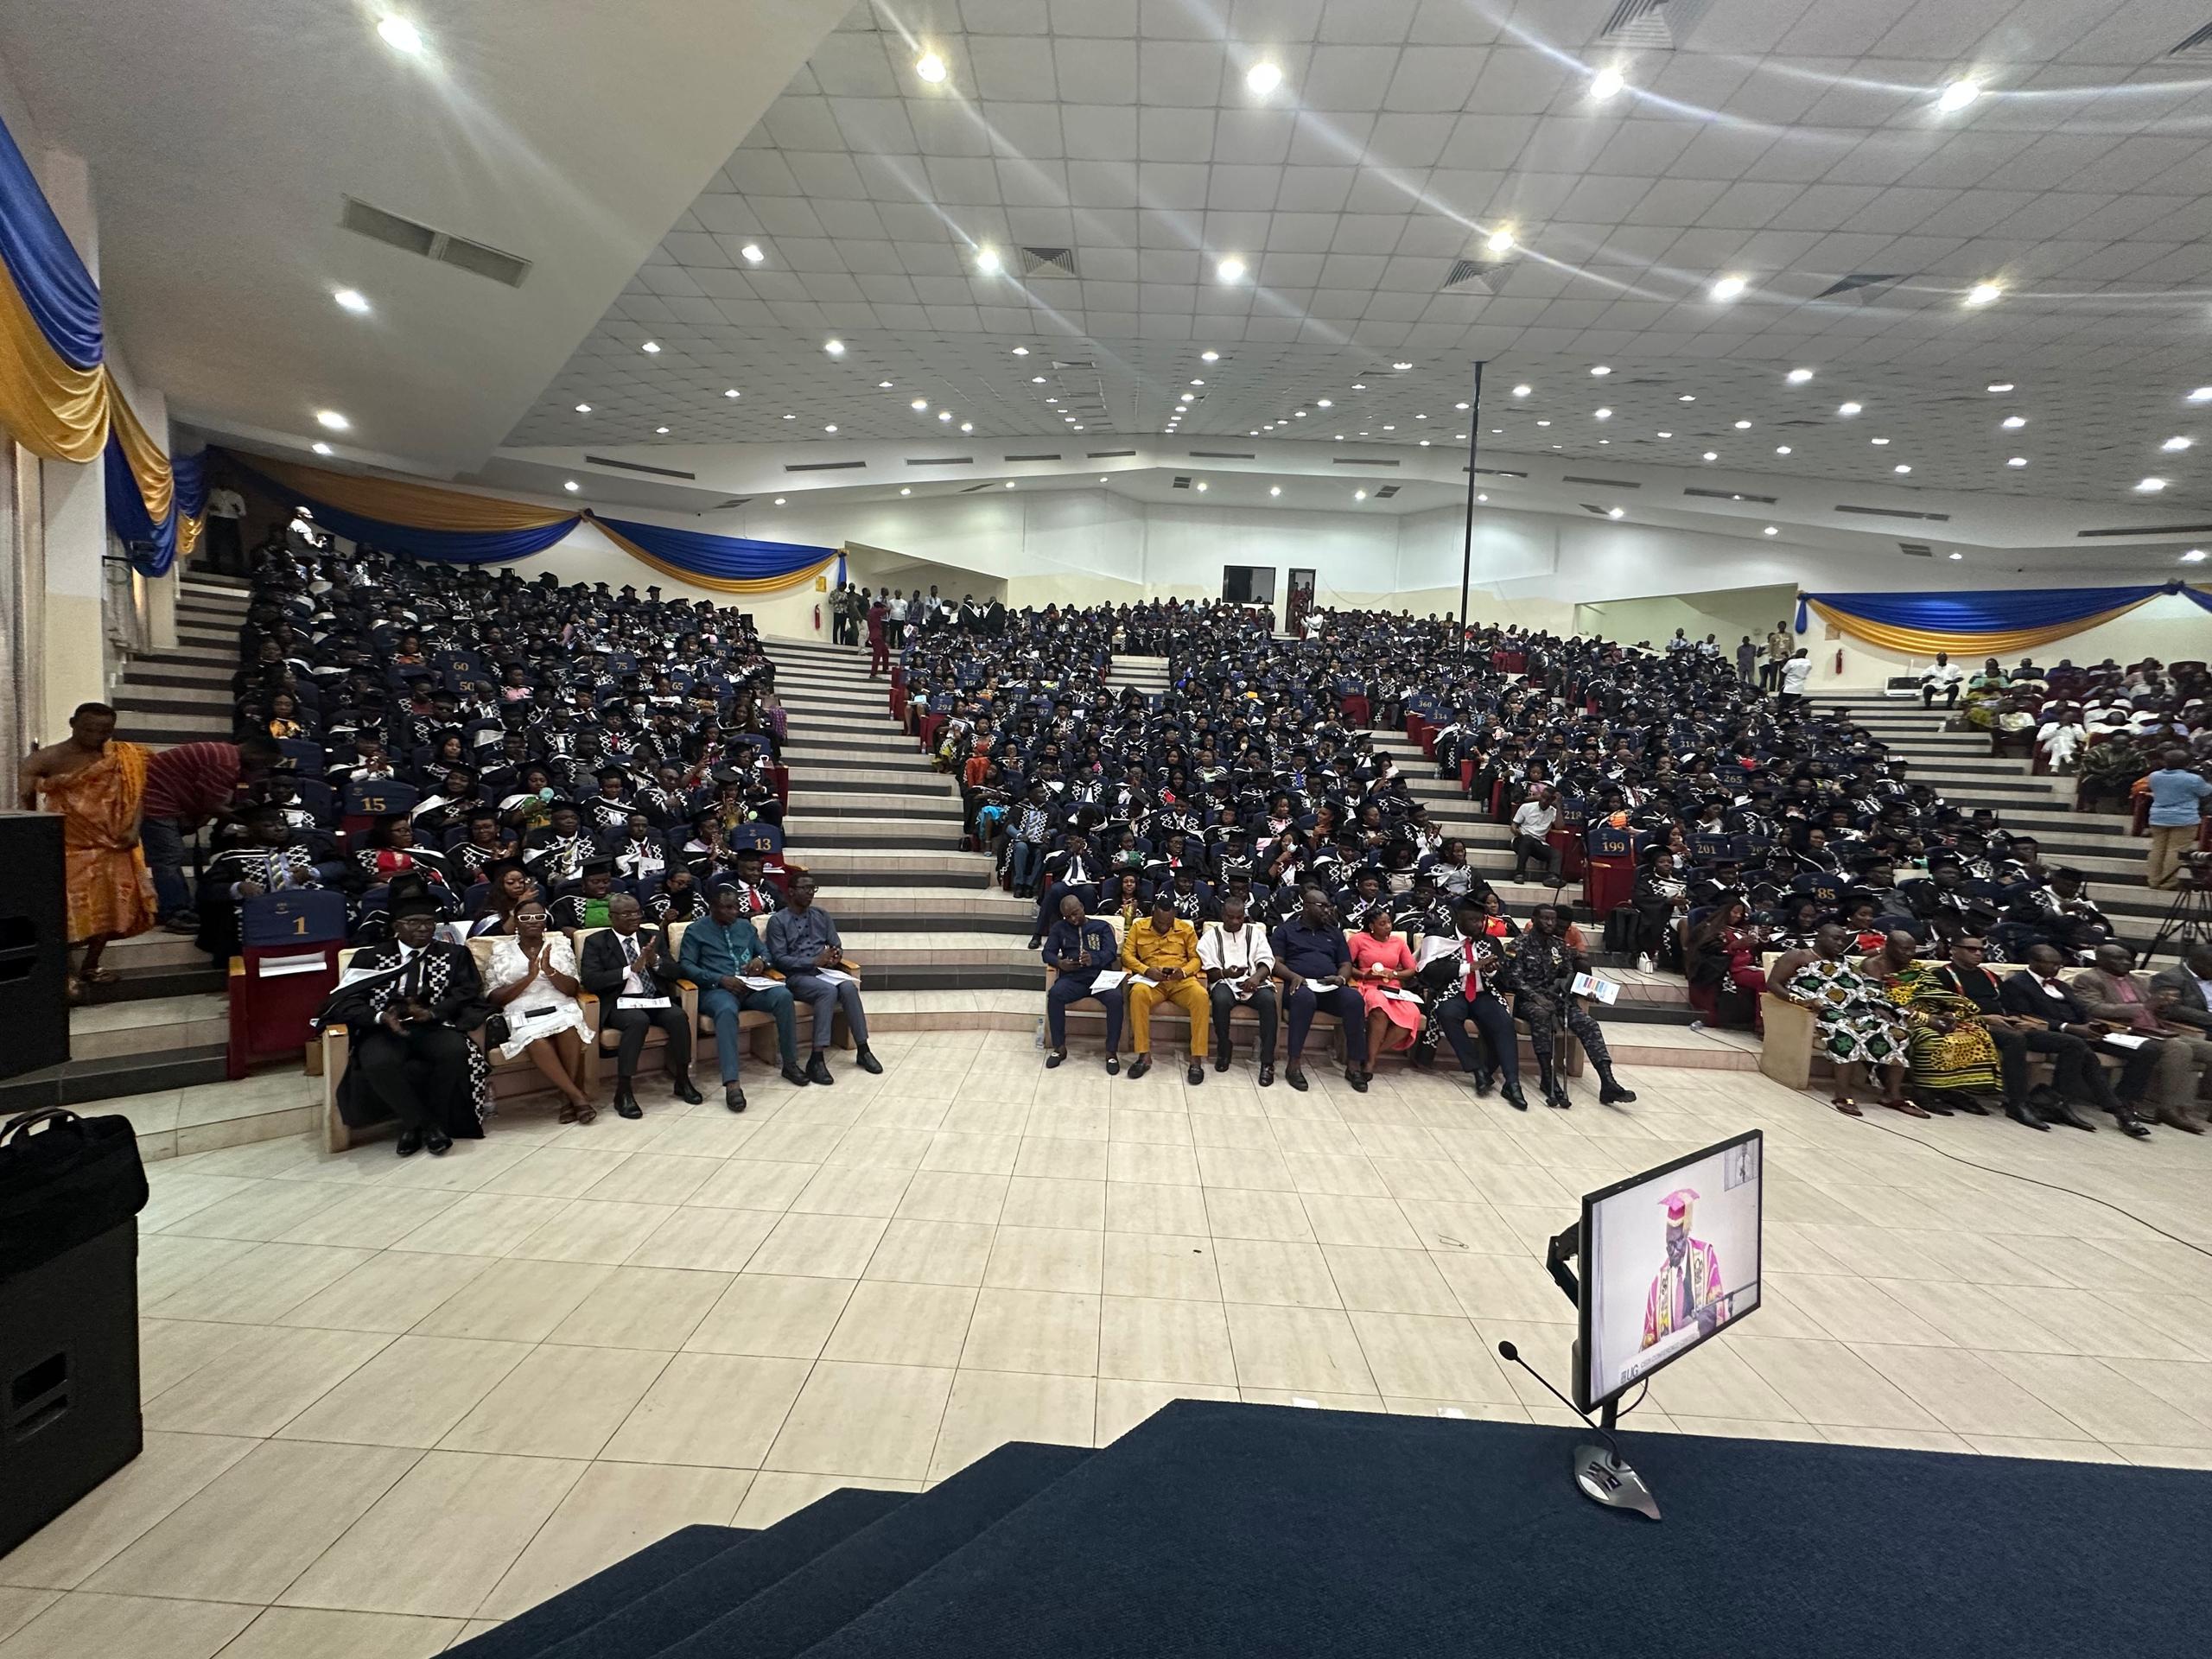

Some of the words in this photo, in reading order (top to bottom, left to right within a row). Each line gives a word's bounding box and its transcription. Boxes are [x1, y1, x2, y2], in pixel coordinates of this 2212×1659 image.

[453, 662, 469, 671] 60
[616, 662, 628, 671] 75
[459, 681, 474, 691] 50
[672, 682, 683, 690] 65
[1724, 774, 1743, 785] 265
[361, 798, 387, 811] 15
[754, 837, 772, 851] 13
[1602, 842, 1624, 852] 199
[1696, 844, 1717, 855] 201
[292, 916, 309, 935] 1
